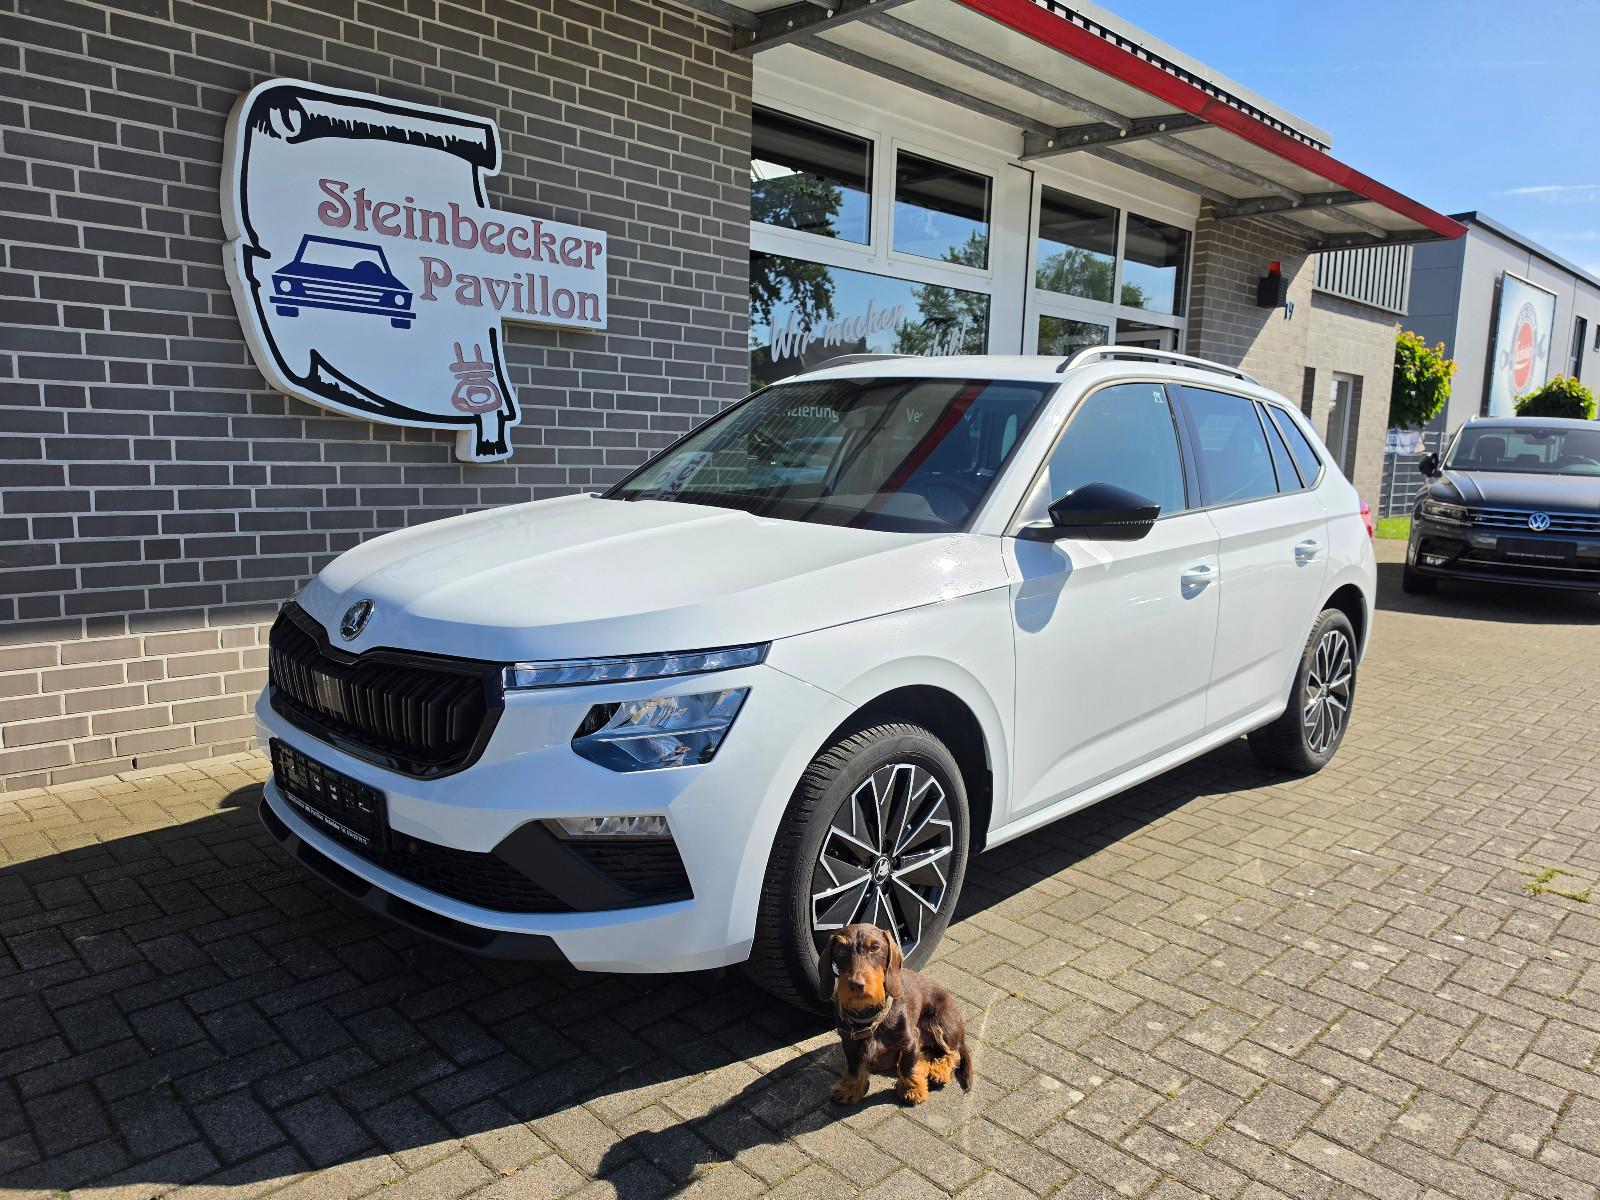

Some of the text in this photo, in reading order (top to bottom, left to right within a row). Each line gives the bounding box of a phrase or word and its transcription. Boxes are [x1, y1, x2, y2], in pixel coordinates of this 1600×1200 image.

[317, 178, 603, 270] Steinbecker
[419, 256, 602, 322] Pavillon
[769, 311, 816, 362] Wir
[822, 298, 904, 348] machen
